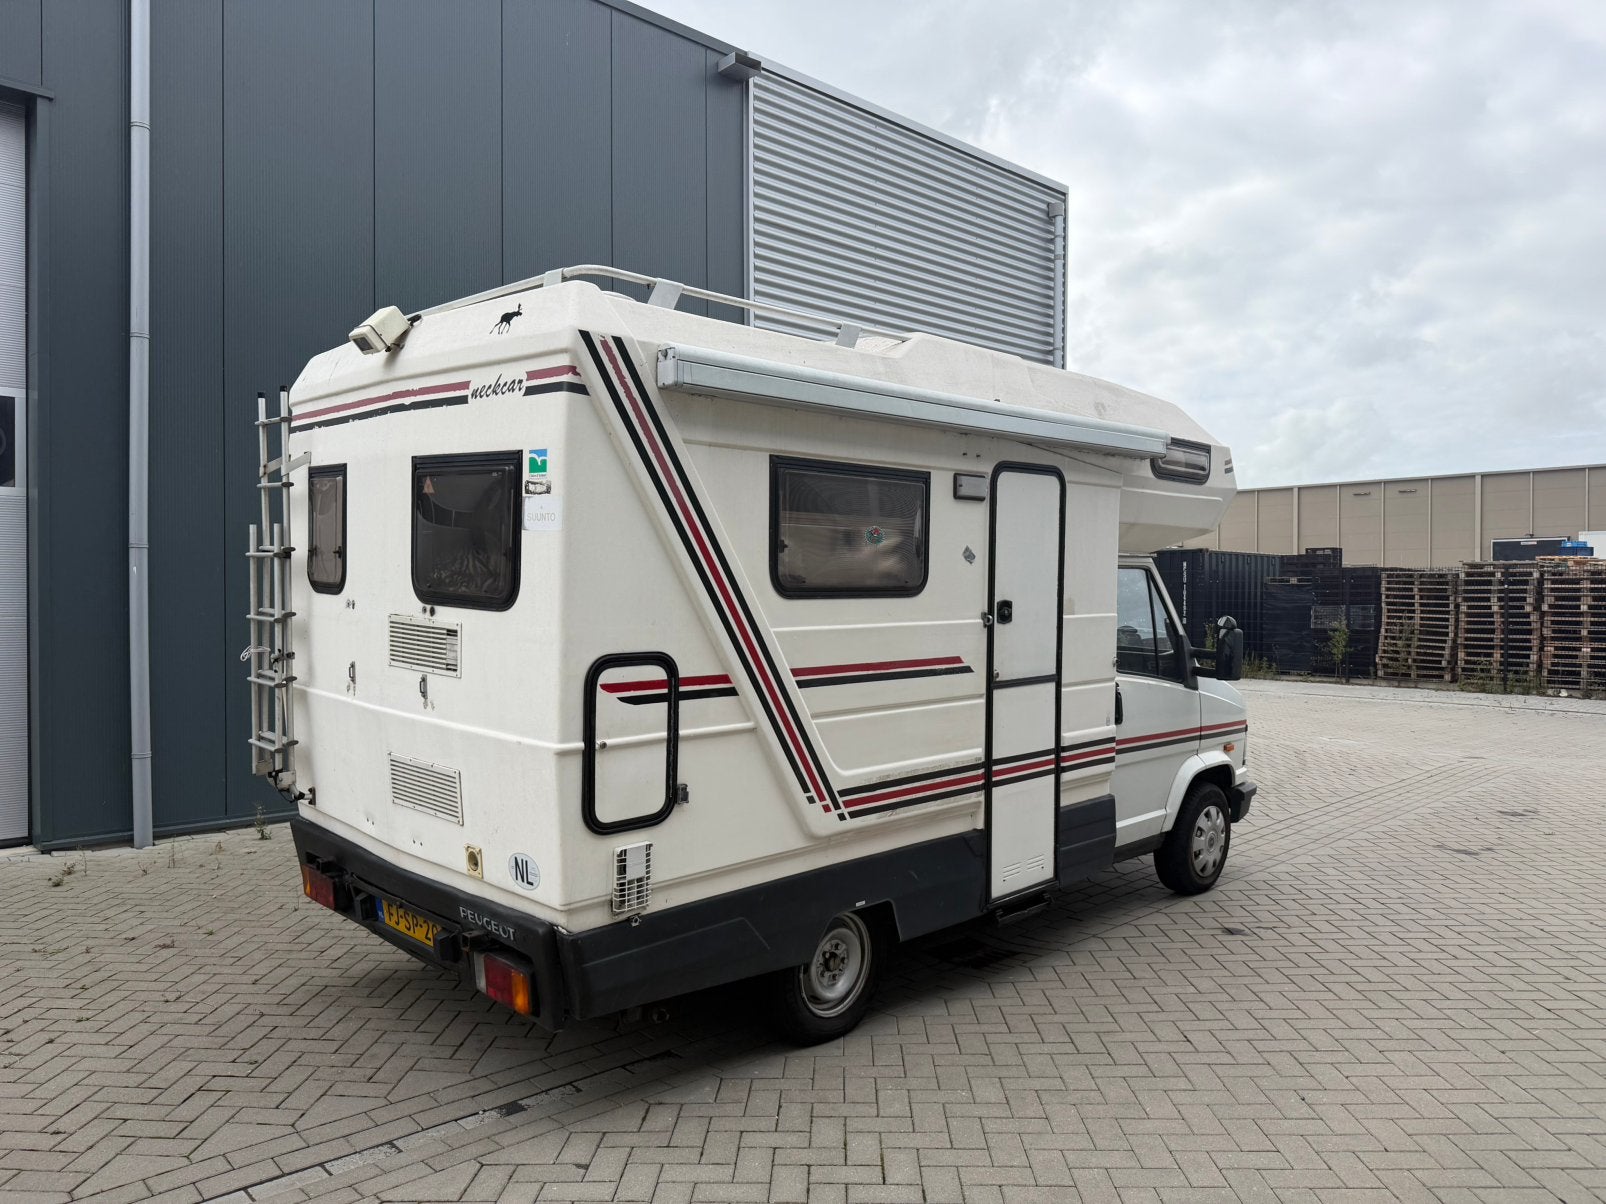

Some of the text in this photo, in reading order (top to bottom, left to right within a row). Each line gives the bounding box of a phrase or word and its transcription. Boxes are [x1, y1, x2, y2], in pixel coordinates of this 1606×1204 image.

[470, 373, 525, 400] neckcar
[526, 512, 556, 522] SUUNTO
[514, 856, 534, 886] NL
[459, 906, 515, 940] PEUGEOT
